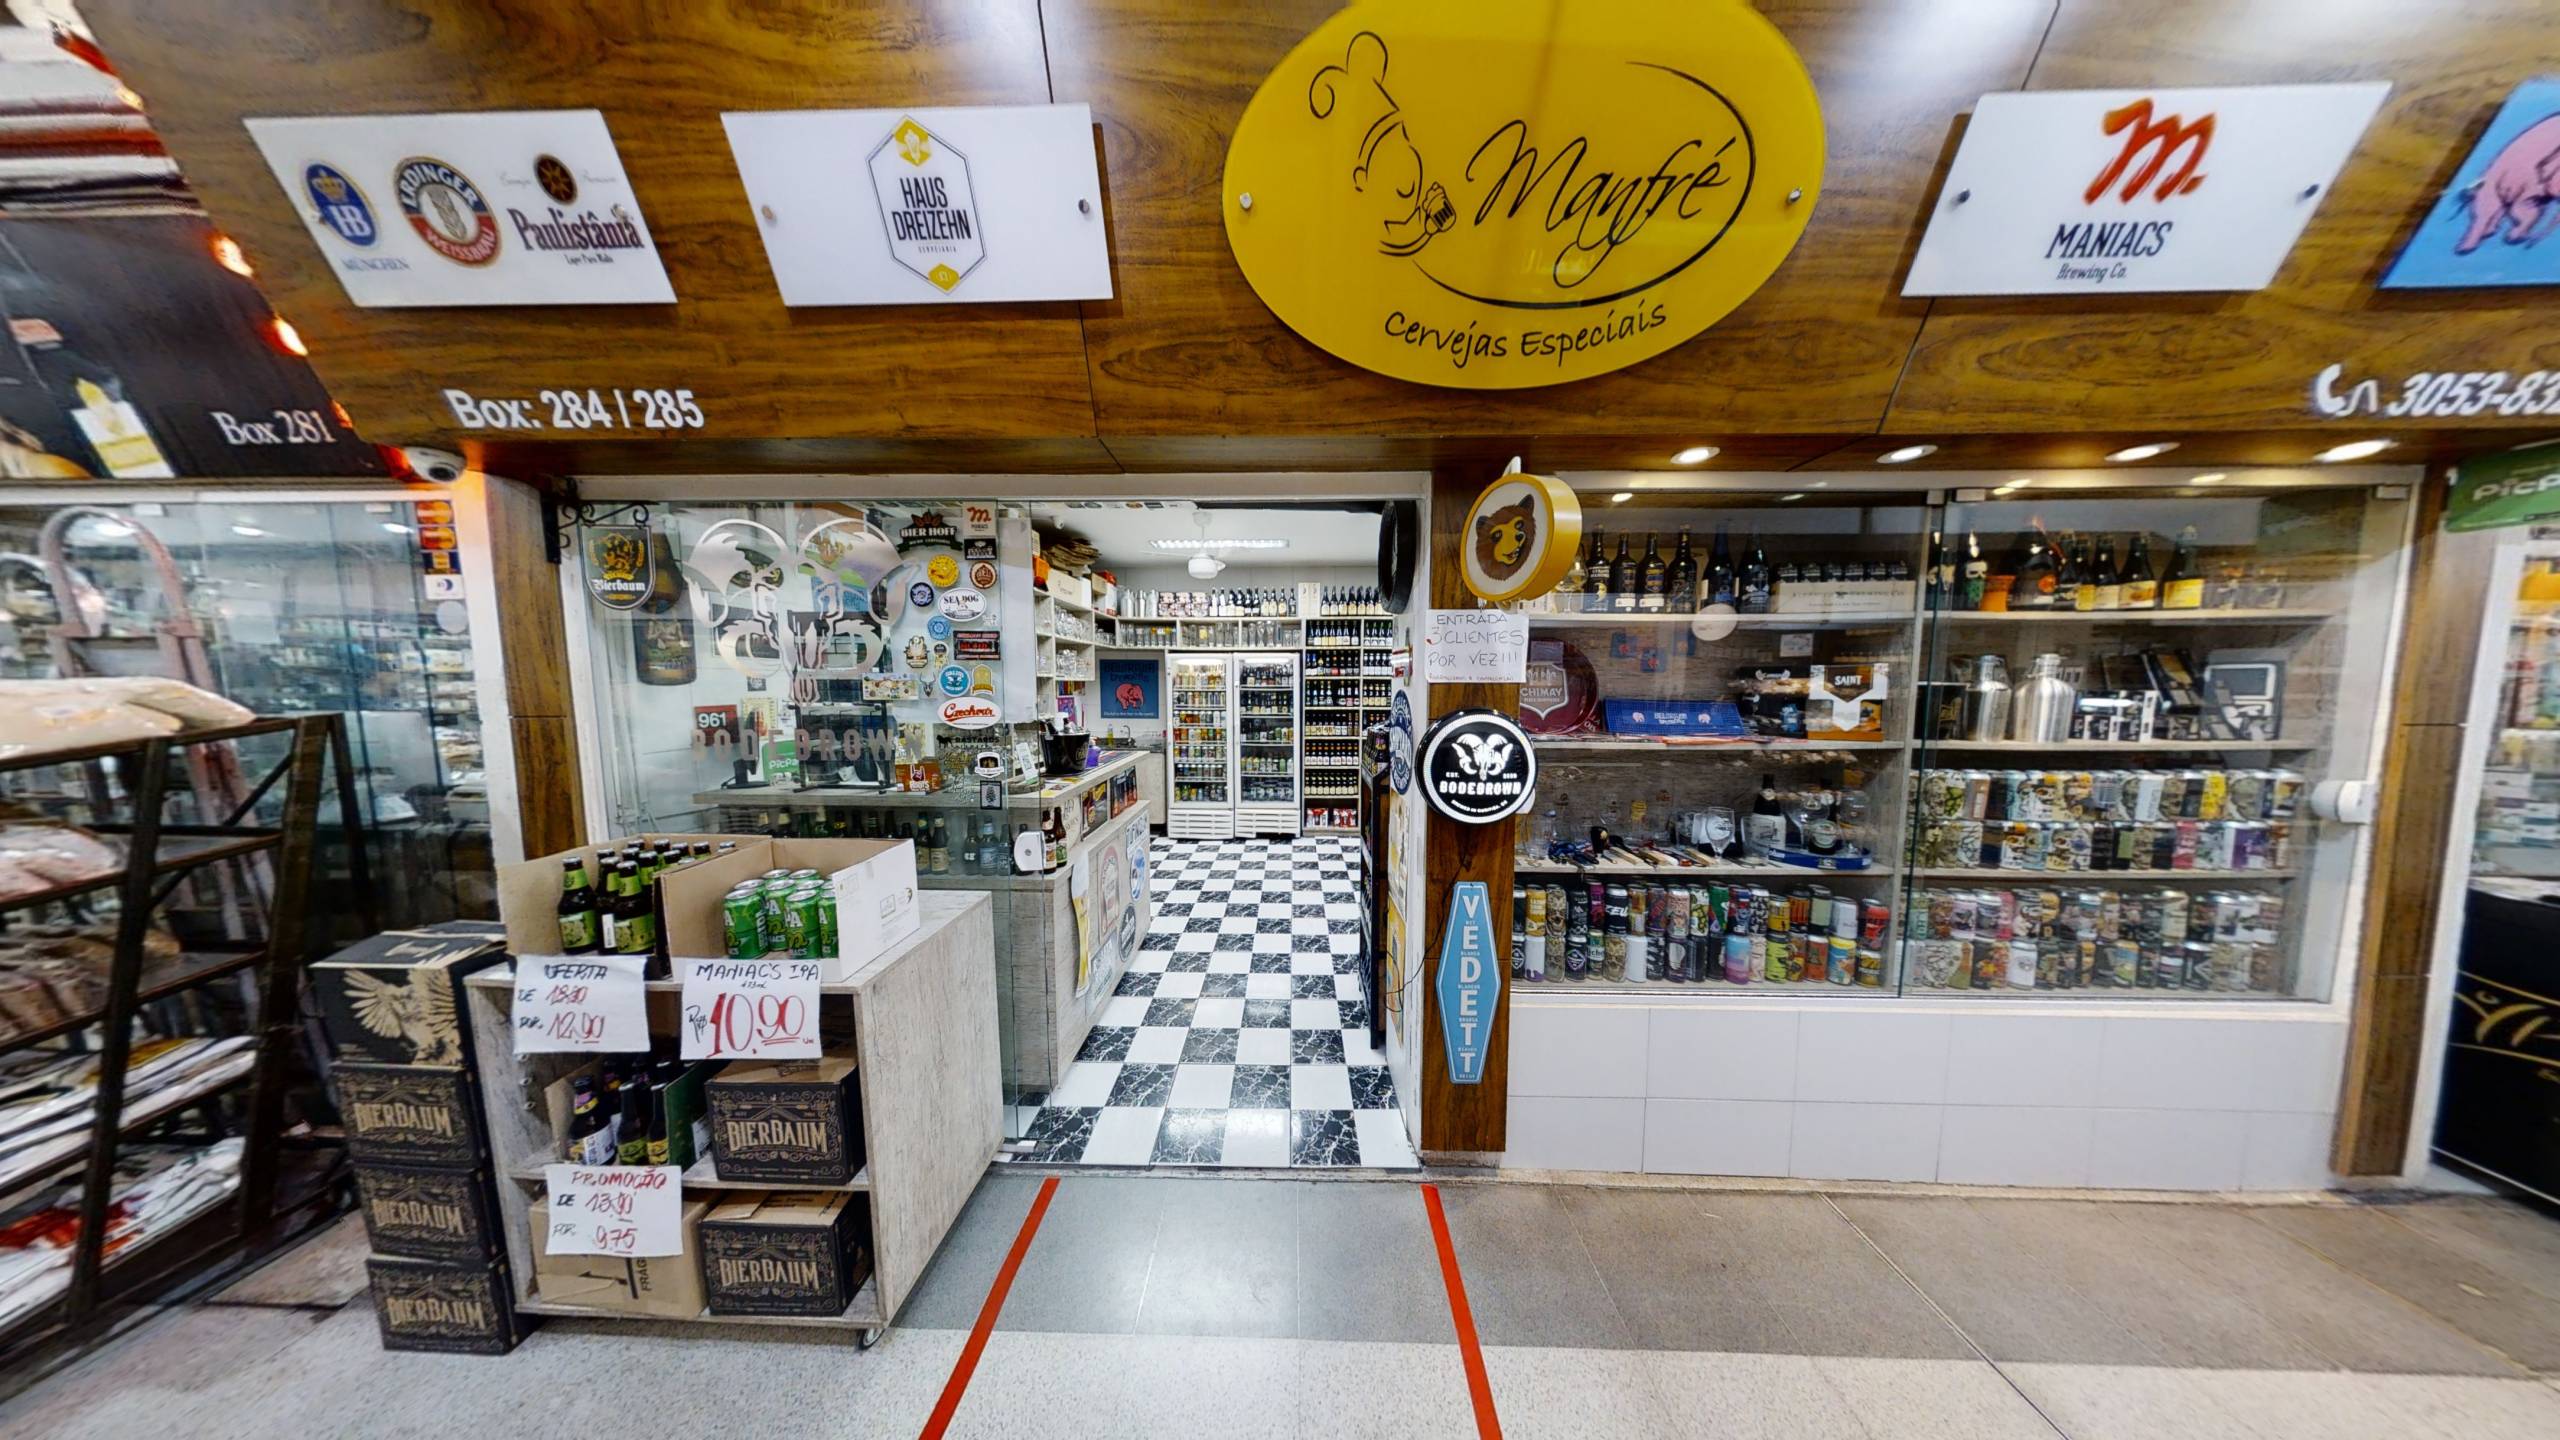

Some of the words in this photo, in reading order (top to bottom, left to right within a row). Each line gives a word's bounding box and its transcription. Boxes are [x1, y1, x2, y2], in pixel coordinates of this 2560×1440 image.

[399, 164, 480, 210] ERDINGER
[899, 177, 948, 209] HAUS
[1465, 119, 1736, 288] Manfré
[506, 206, 645, 251] Paulistânia
[891, 209, 972, 241] DREIZEHN
[2044, 221, 2174, 259] MANIACS
[2056, 262, 2110, 284] Brewing
[1385, 311, 1507, 368] Cervejas
[1520, 299, 1667, 367] Especiais
[444, 389, 543, 429] Box:
[539, 389, 613, 429] 284
[632, 389, 705, 428] 285
[210, 411, 283, 445] Box
[273, 409, 337, 443] 281
[901, 528, 927, 537] BIER
[928, 526, 957, 536] HOFF
[591, 579, 646, 592] Bierbaum
[943, 595, 961, 606] SEA
[1436, 613, 1508, 625] ENTRADA
[1444, 629, 1525, 646] CLIENTES
[1427, 651, 1457, 668] POR
[1519, 686, 1563, 698] CHIMAY
[1834, 674, 1863, 687] SAINT
[698, 712, 727, 729] 961
[1440, 780, 1522, 796] BODEBROWN
[543, 963, 608, 979] OFERTA
[789, 964, 820, 981] IPA
[1459, 895, 1482, 1073] VEDETT
[517, 988, 536, 1002] DE
[354, 1101, 453, 1138] BIERBAUM
[726, 1119, 829, 1154] BIERBAUM
[556, 1193, 576, 1207] DE
[371, 1198, 464, 1237] BIERBAUM
[718, 1258, 820, 1291] BIERBAUM
[386, 1297, 486, 1331] BIERBAUM
